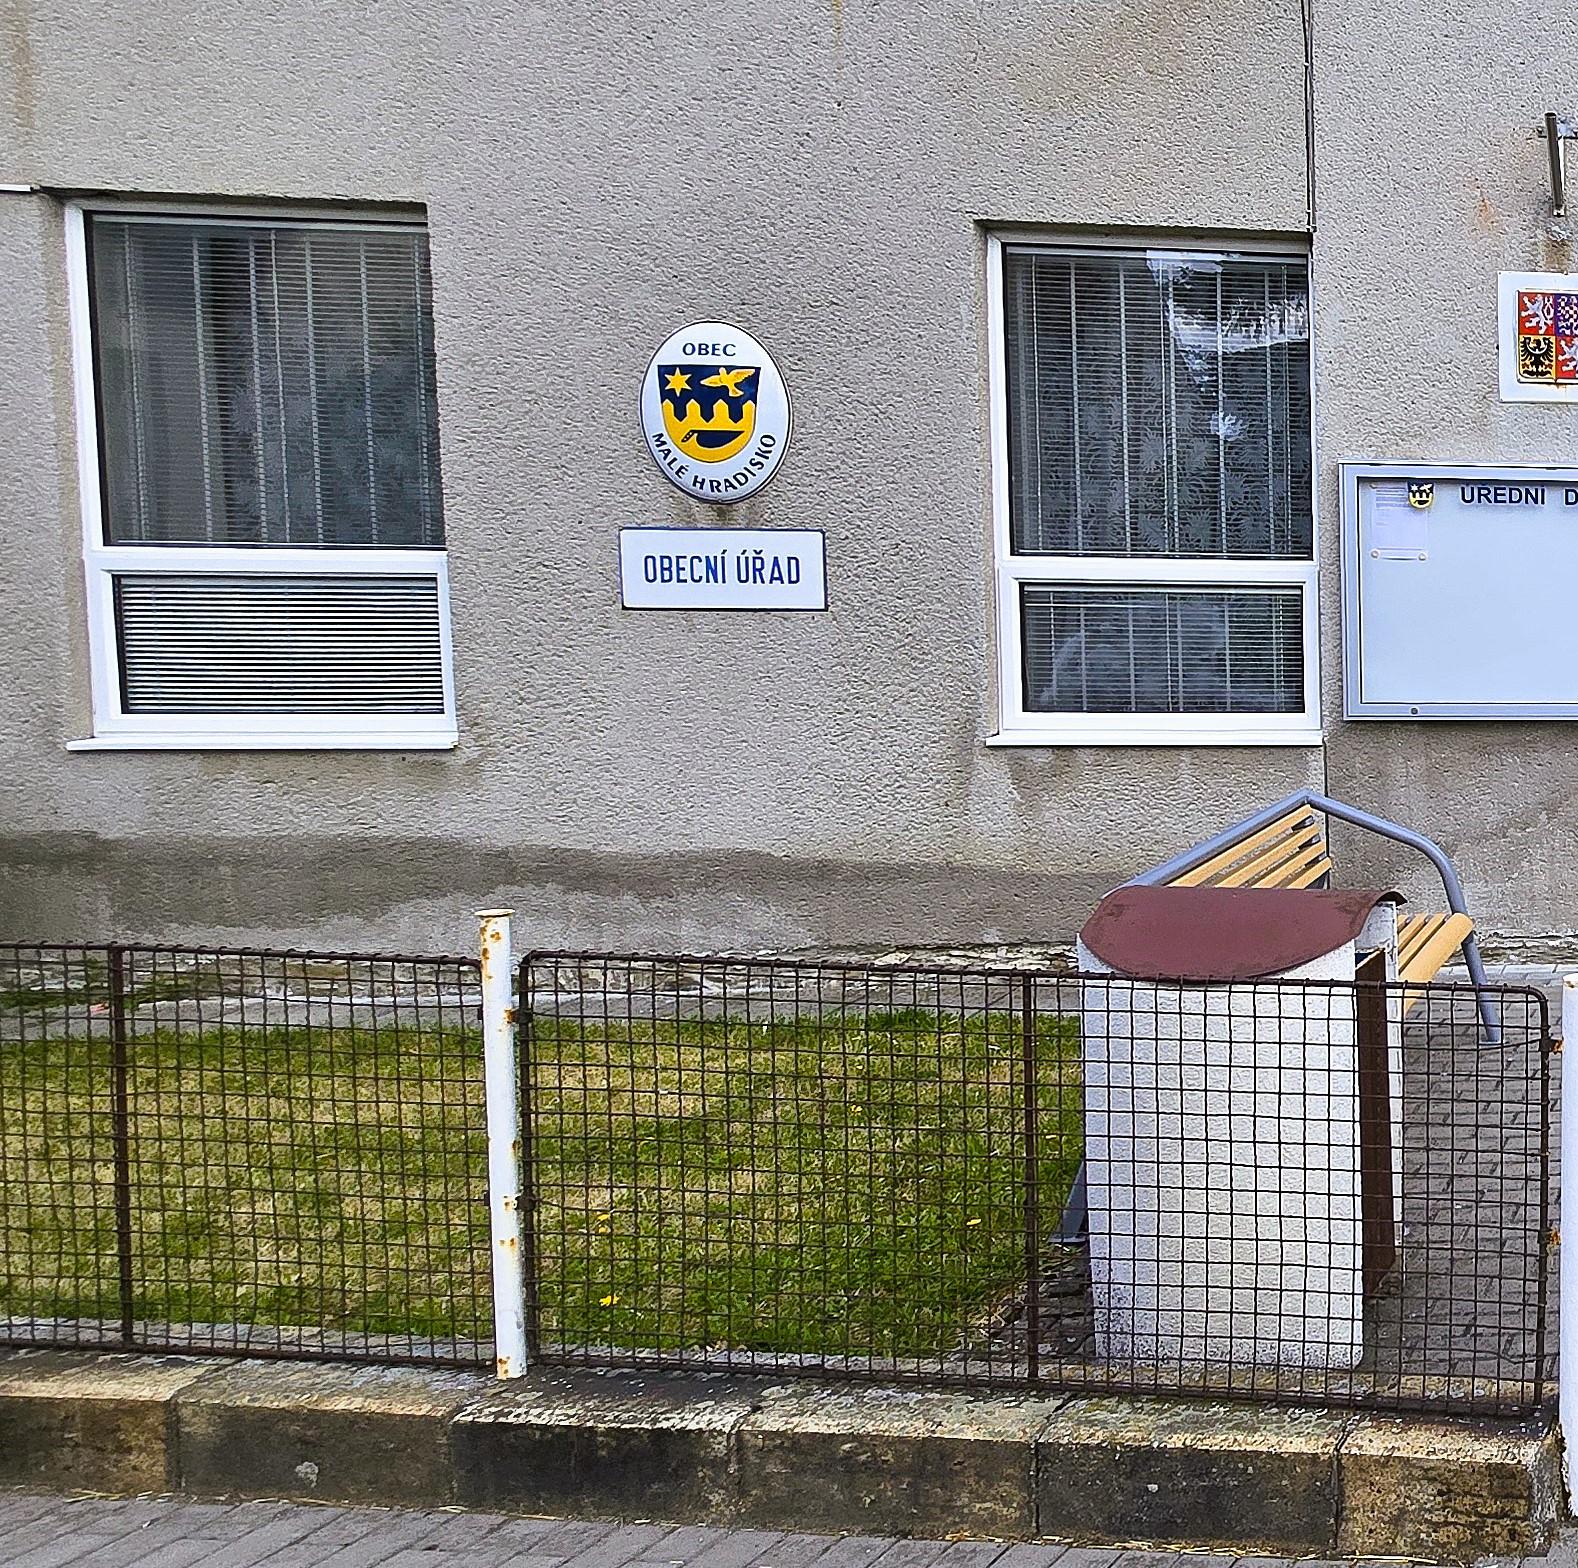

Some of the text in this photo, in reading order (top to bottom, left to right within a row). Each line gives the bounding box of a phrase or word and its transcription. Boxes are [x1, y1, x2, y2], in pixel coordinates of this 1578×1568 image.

[682, 342, 737, 357] OBEC
[652, 432, 776, 493] MALÉ HRADISKO
[643, 549, 801, 584] OBECNÍ ÚŘAD
